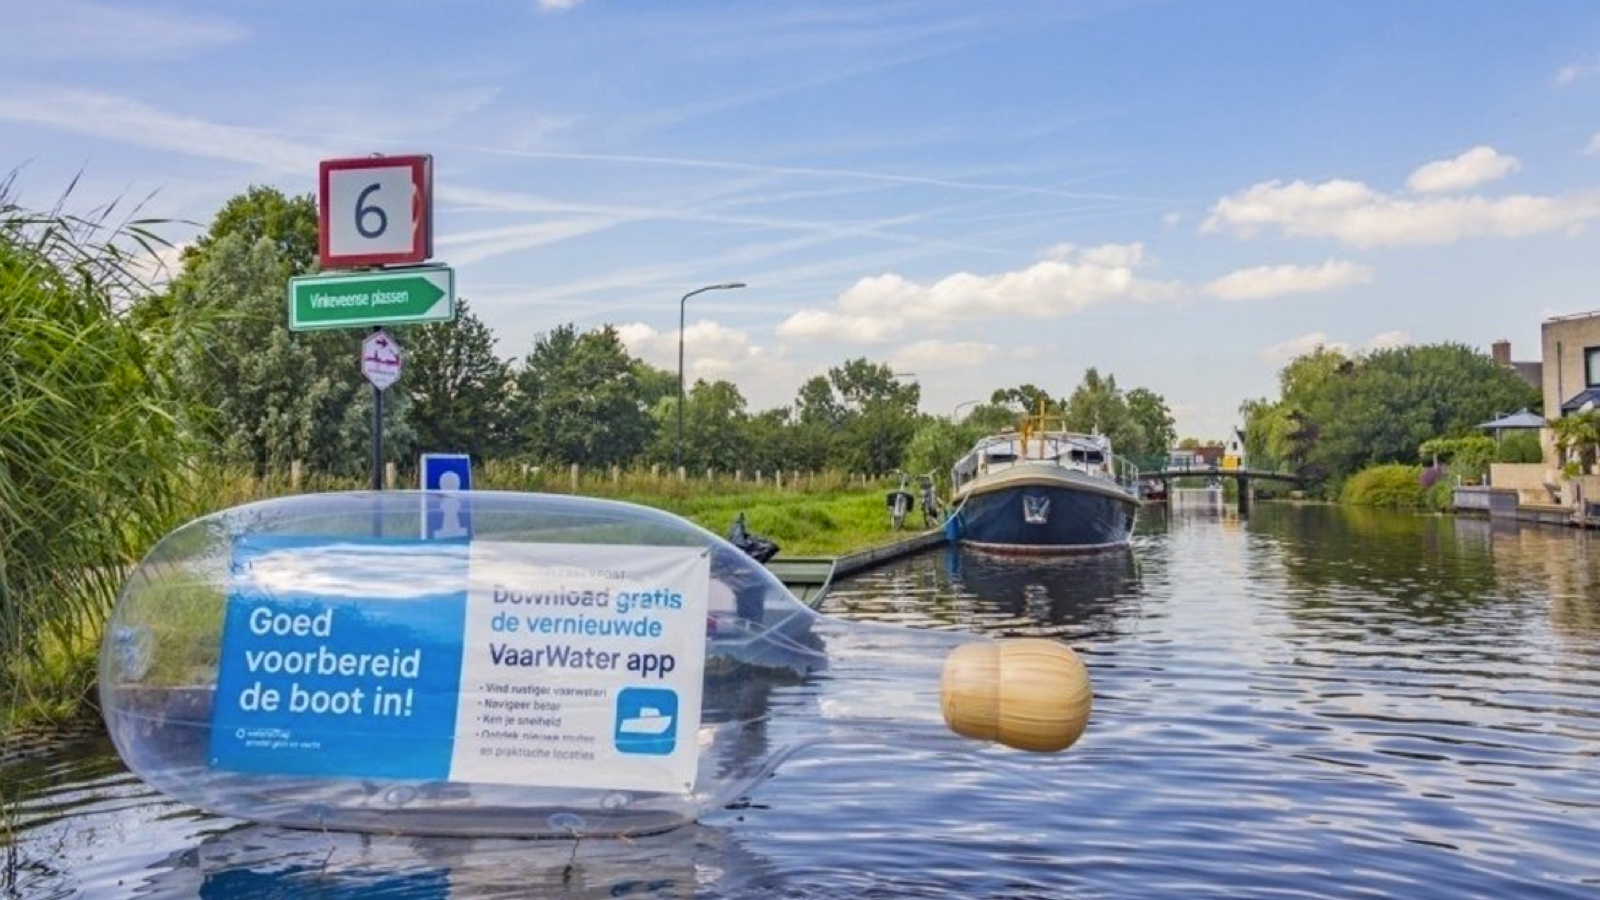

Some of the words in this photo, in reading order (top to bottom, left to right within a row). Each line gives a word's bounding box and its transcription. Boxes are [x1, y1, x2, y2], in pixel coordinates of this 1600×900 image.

[355, 182, 388, 239] 6
[310, 292, 369, 309] Vinkeveense
[371, 289, 409, 308] plassen
[616, 588, 682, 614] gratis
[250, 606, 332, 637] Goed
[491, 611, 519, 633] de
[527, 614, 662, 637] vernieuwde
[246, 646, 421, 678] voorbereid
[489, 643, 620, 670] VaarWater
[627, 651, 675, 679] app
[240, 682, 280, 711] de
[289, 683, 364, 714] boot
[373, 686, 413, 717] in!
